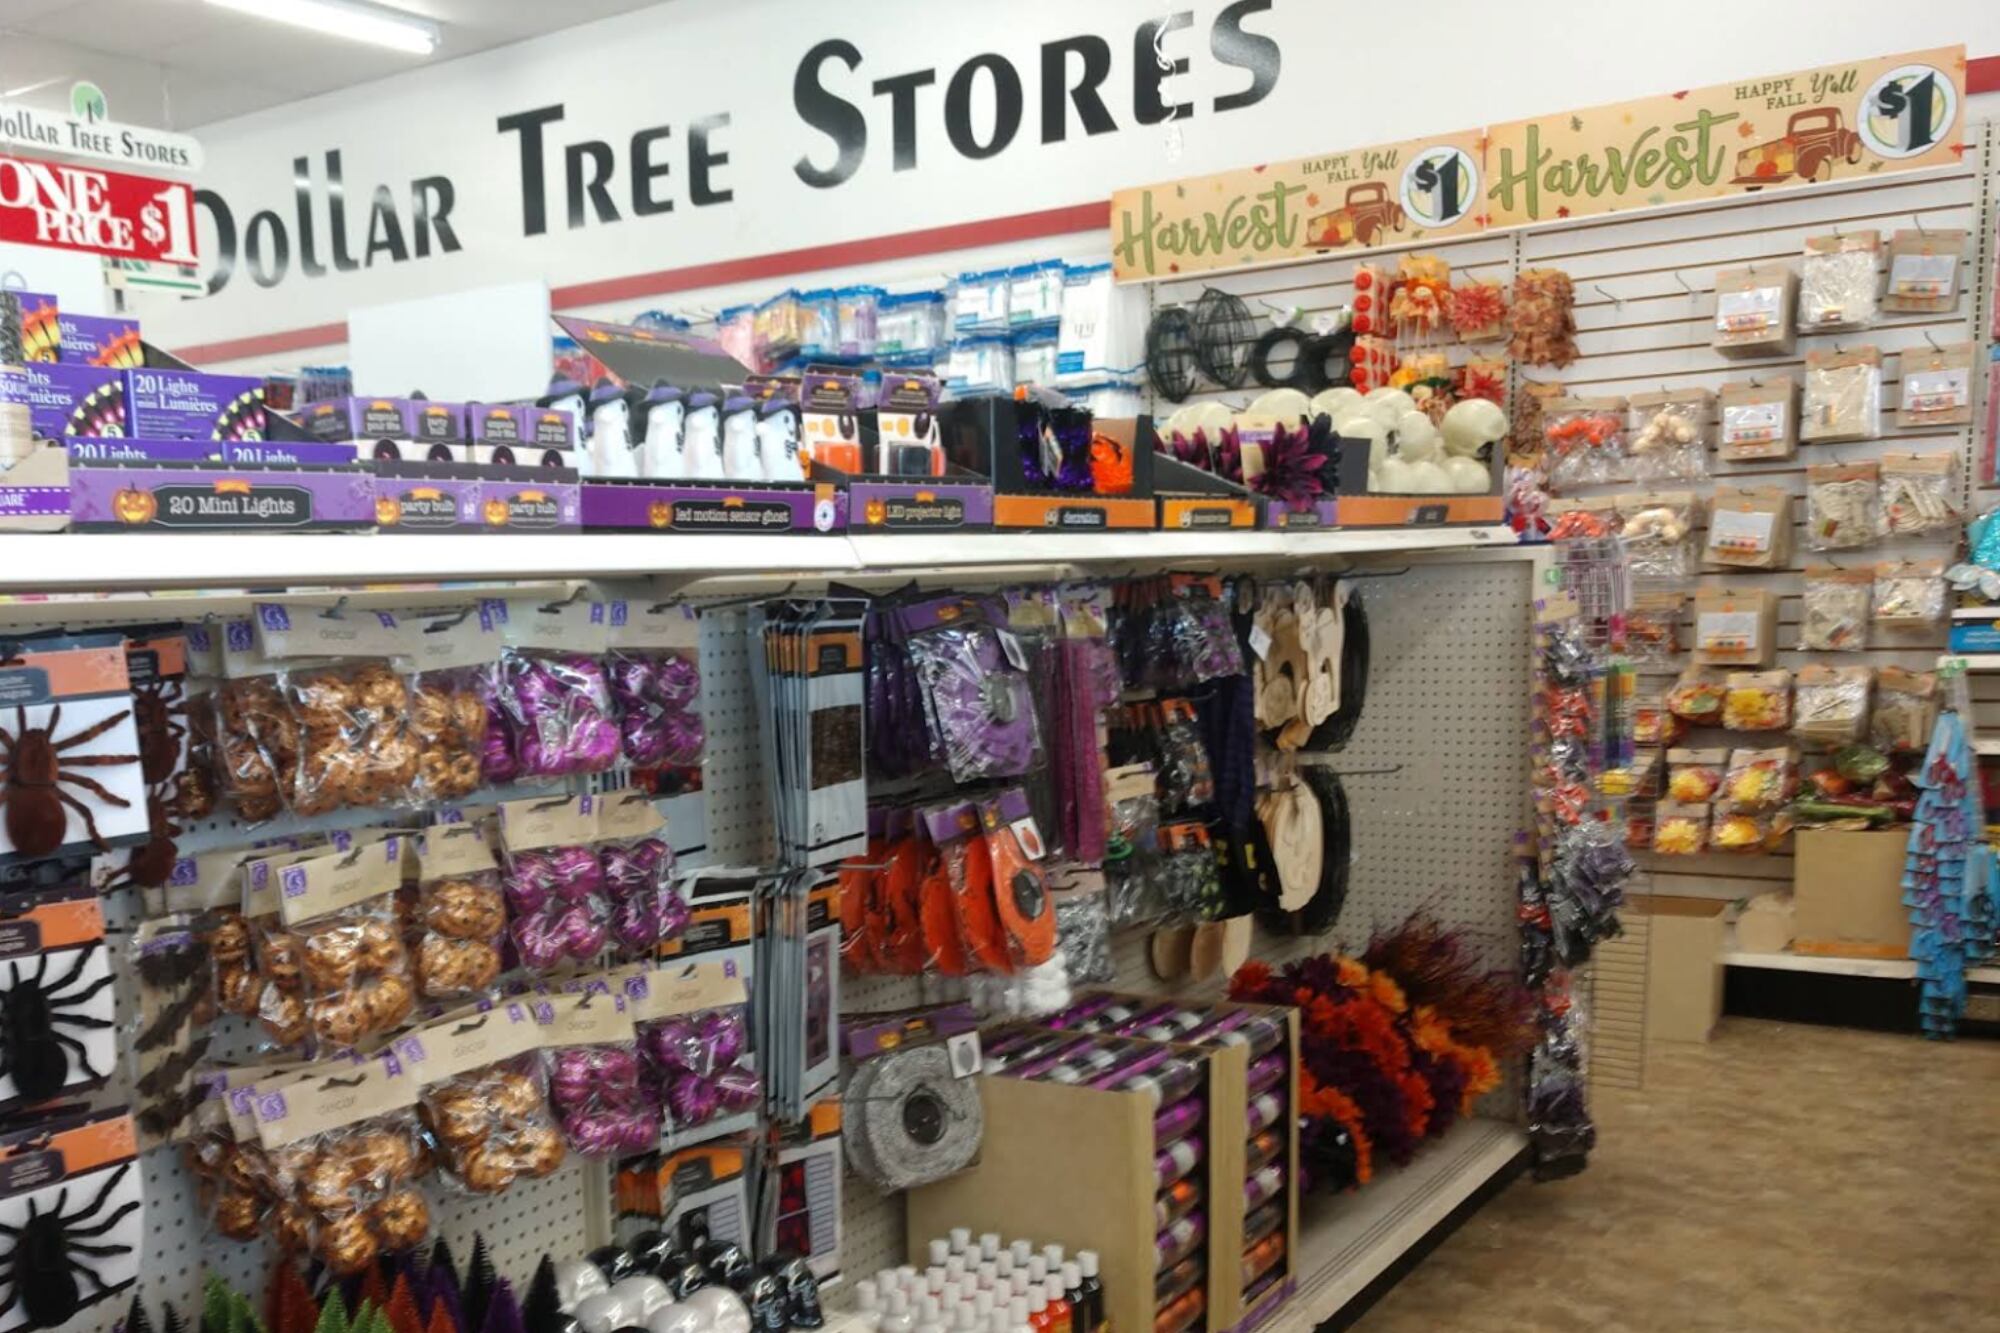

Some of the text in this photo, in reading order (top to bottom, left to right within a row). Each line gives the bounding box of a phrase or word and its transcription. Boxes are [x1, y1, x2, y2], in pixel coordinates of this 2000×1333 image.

[1734, 79, 1795, 101] HAPPY
[1765, 93, 1807, 111] FALL
[1873, 71, 1936, 153] $1
[496, 102, 735, 237] TREE
[791, 0, 1280, 190] STORES
[66, 121, 113, 154] TREE
[121, 131, 189, 166] STORES
[1301, 155, 1349, 176] HAPPY
[1488, 108, 1740, 221] Harvest
[1327, 168, 1360, 184] FALL
[1411, 151, 1462, 223] $1
[0, 160, 111, 218] ONE
[37, 207, 135, 251] PRICE
[140, 185, 199, 262] $1
[1114, 180, 1308, 275] Harvest
[135, 374, 200, 396] 20 Lights
[159, 394, 218, 413] Lumières
[169, 496, 296, 518] 20 Mini Lights
[401, 500, 456, 515] party bulb
[509, 501, 558, 516] party bulb
[676, 507, 790, 526] led motion sensor ghost
[886, 505, 962, 520] LED projector light
